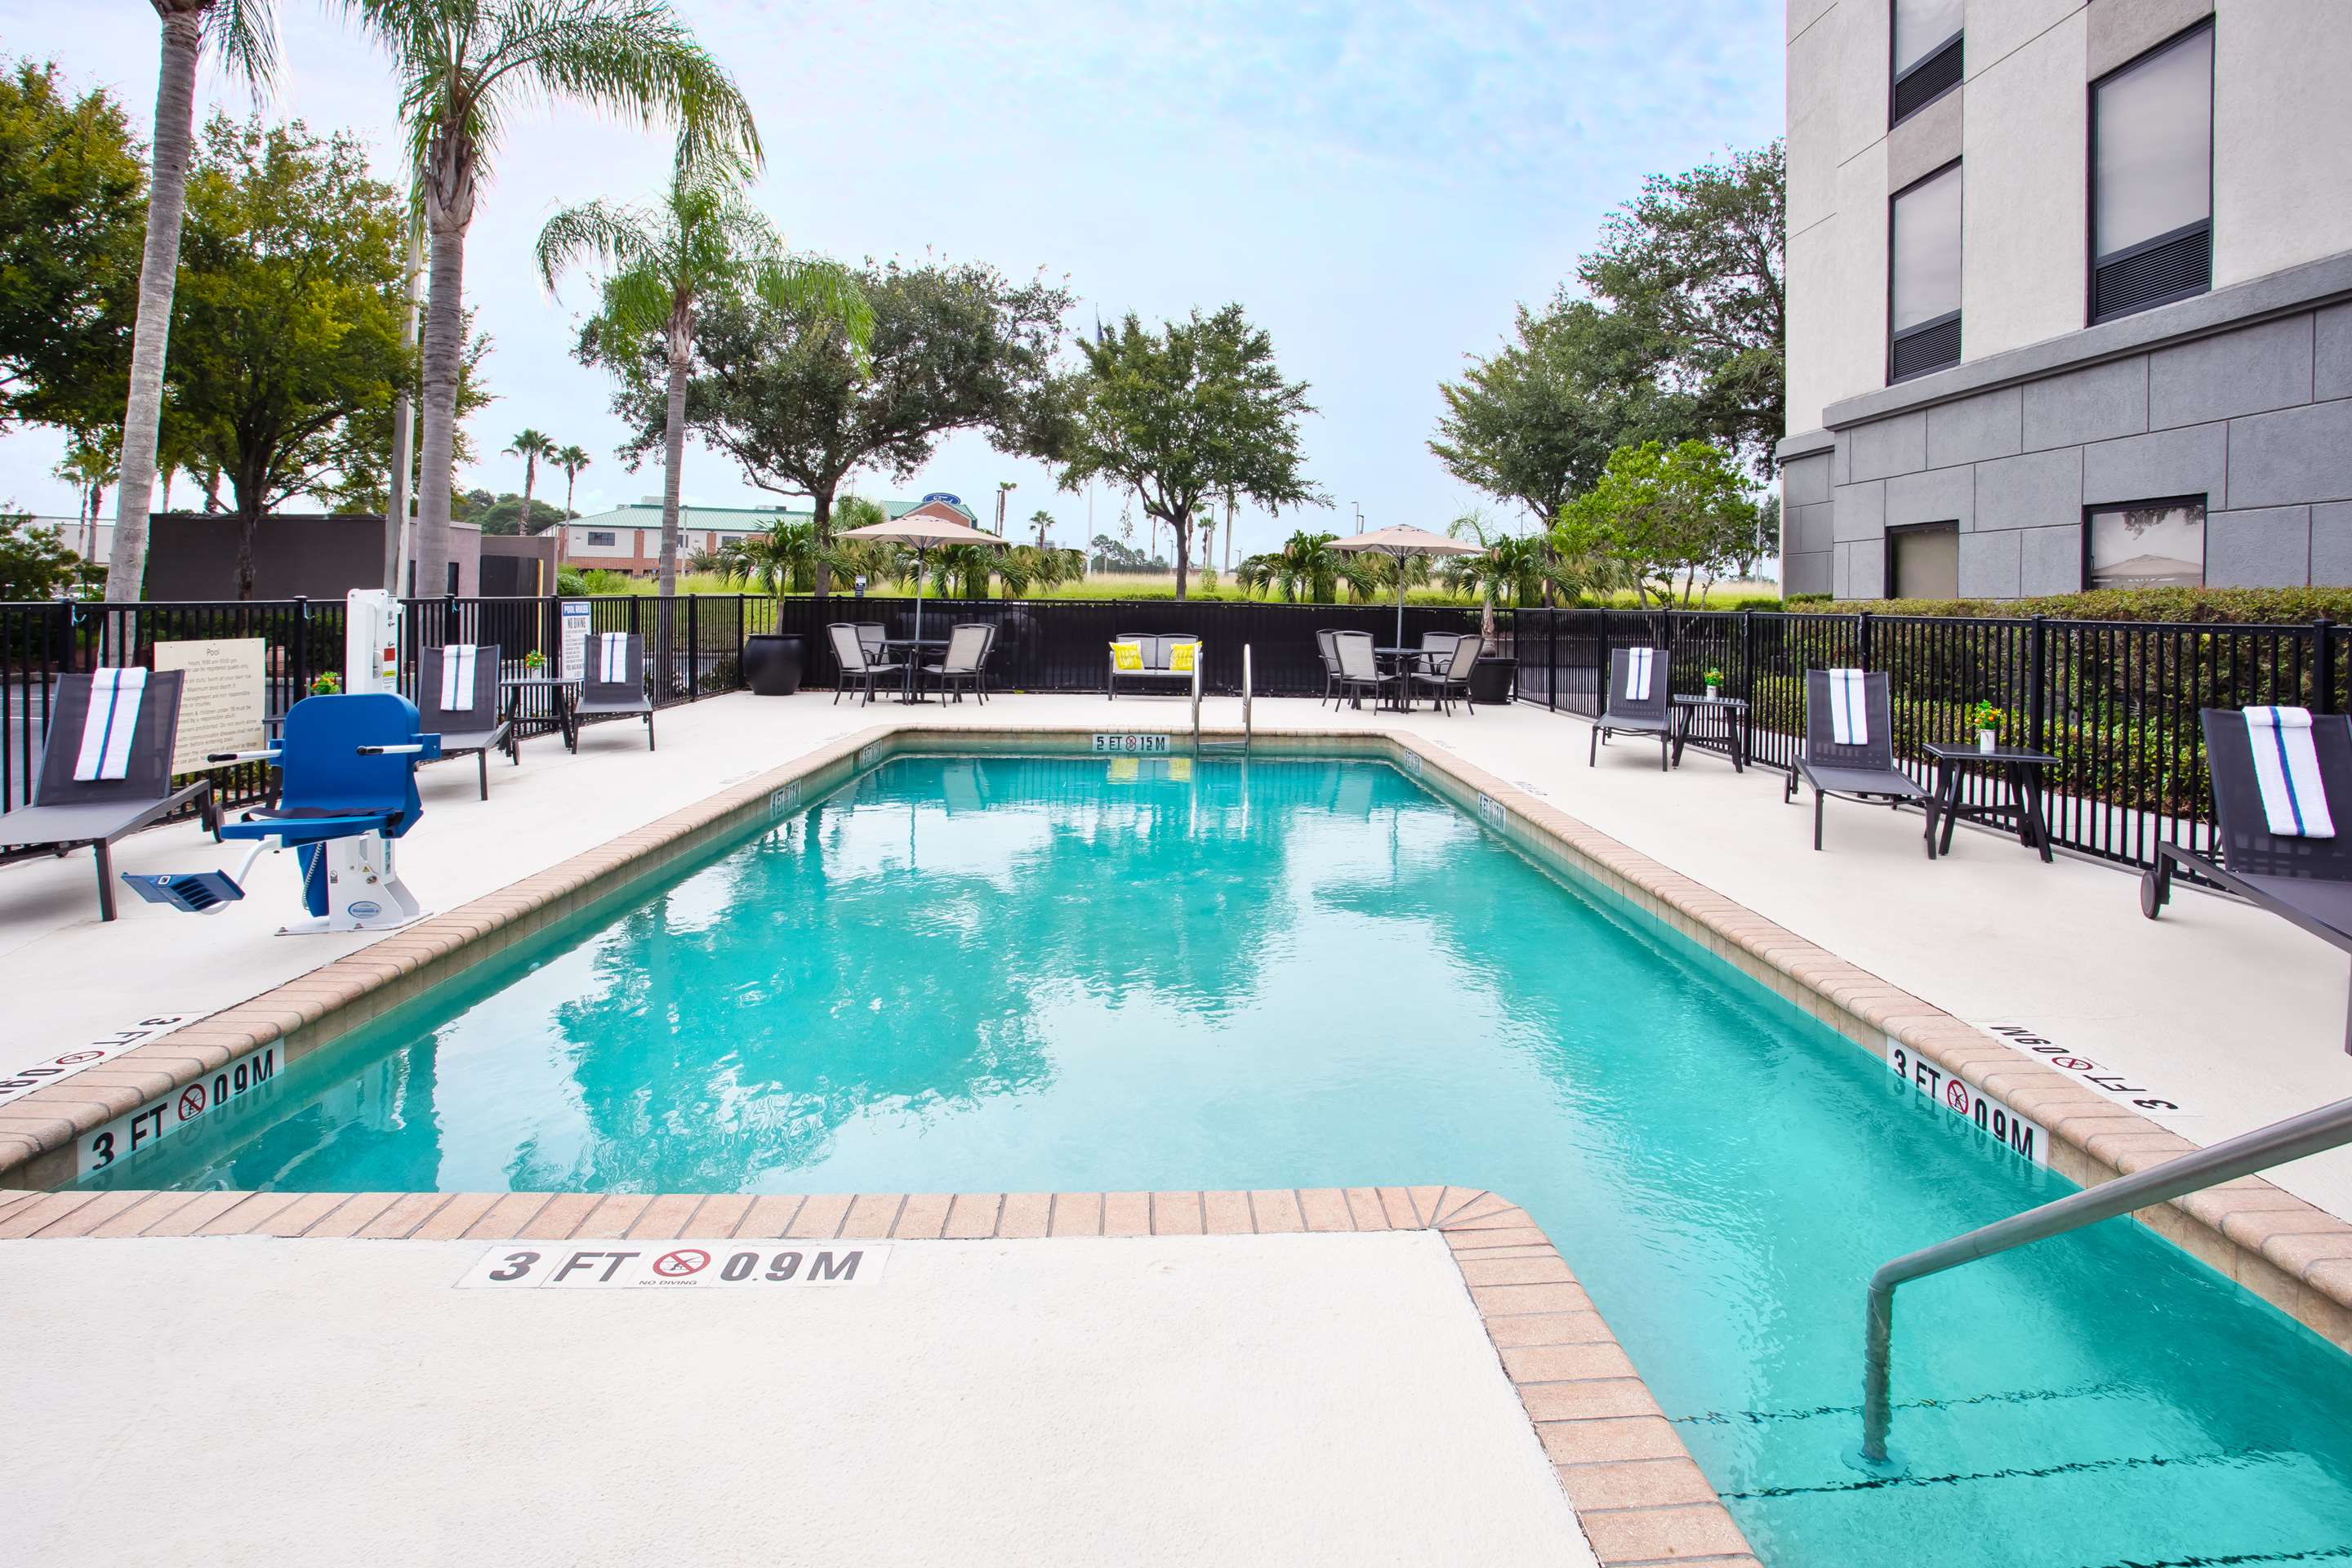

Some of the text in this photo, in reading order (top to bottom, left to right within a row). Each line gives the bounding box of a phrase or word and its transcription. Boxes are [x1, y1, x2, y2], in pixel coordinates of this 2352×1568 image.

[564, 605, 575, 614] POOL
[207, 648, 220, 657] Pool
[139, 1018, 182, 1026] 3
[91, 1031, 154, 1045] FT
[1894, 1049, 1906, 1078] 3
[1916, 1060, 1940, 1099] FT
[2082, 1075, 2148, 1092] FT
[2132, 1099, 2179, 1110] 3
[92, 1132, 114, 1170] 3
[131, 1102, 168, 1152] FT
[488, 1251, 864, 1282] 3 FT 0.9M
